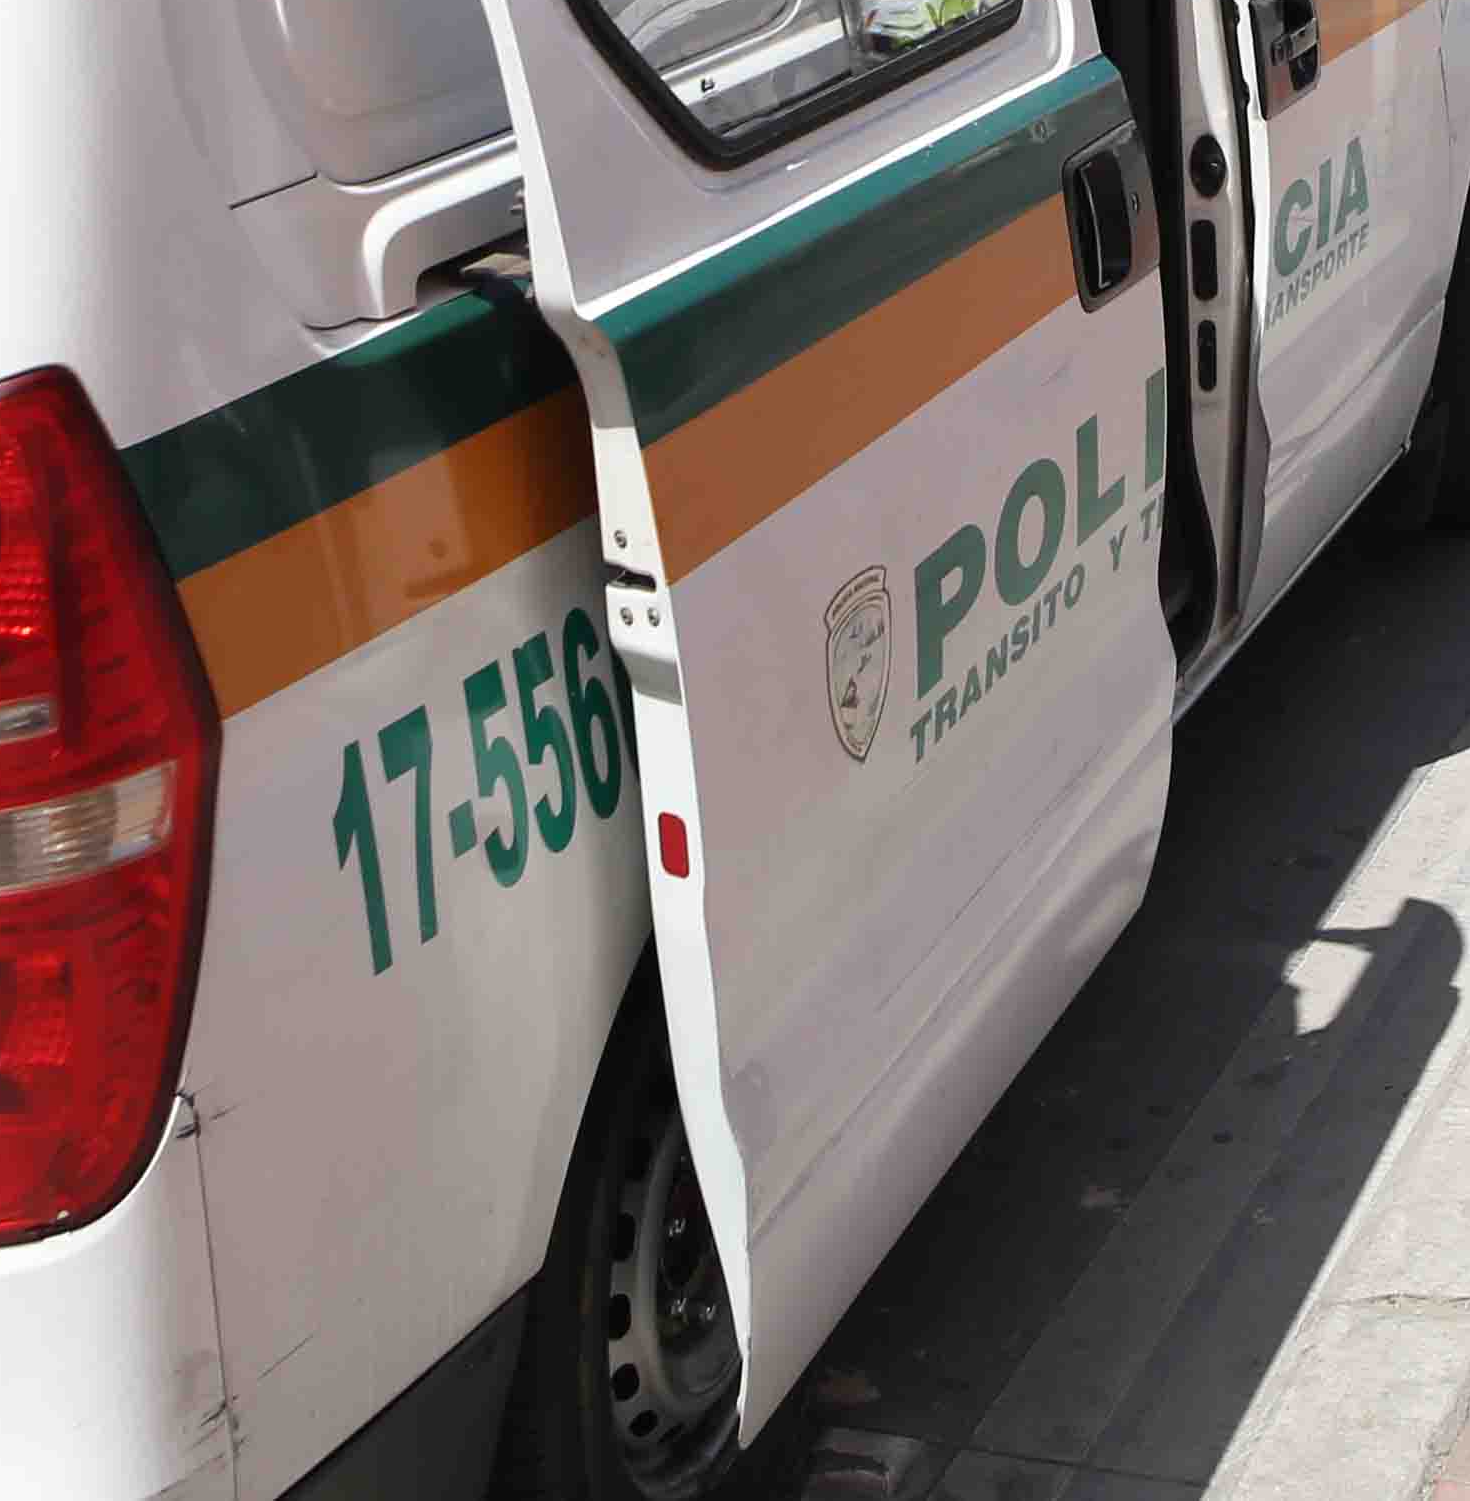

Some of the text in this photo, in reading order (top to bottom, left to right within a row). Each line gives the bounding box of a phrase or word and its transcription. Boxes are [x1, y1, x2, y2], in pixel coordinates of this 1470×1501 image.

[332, 607, 640, 977] 17-556
[910, 562, 1086, 764] TRANSITO
[1109, 522, 1129, 573] Y
